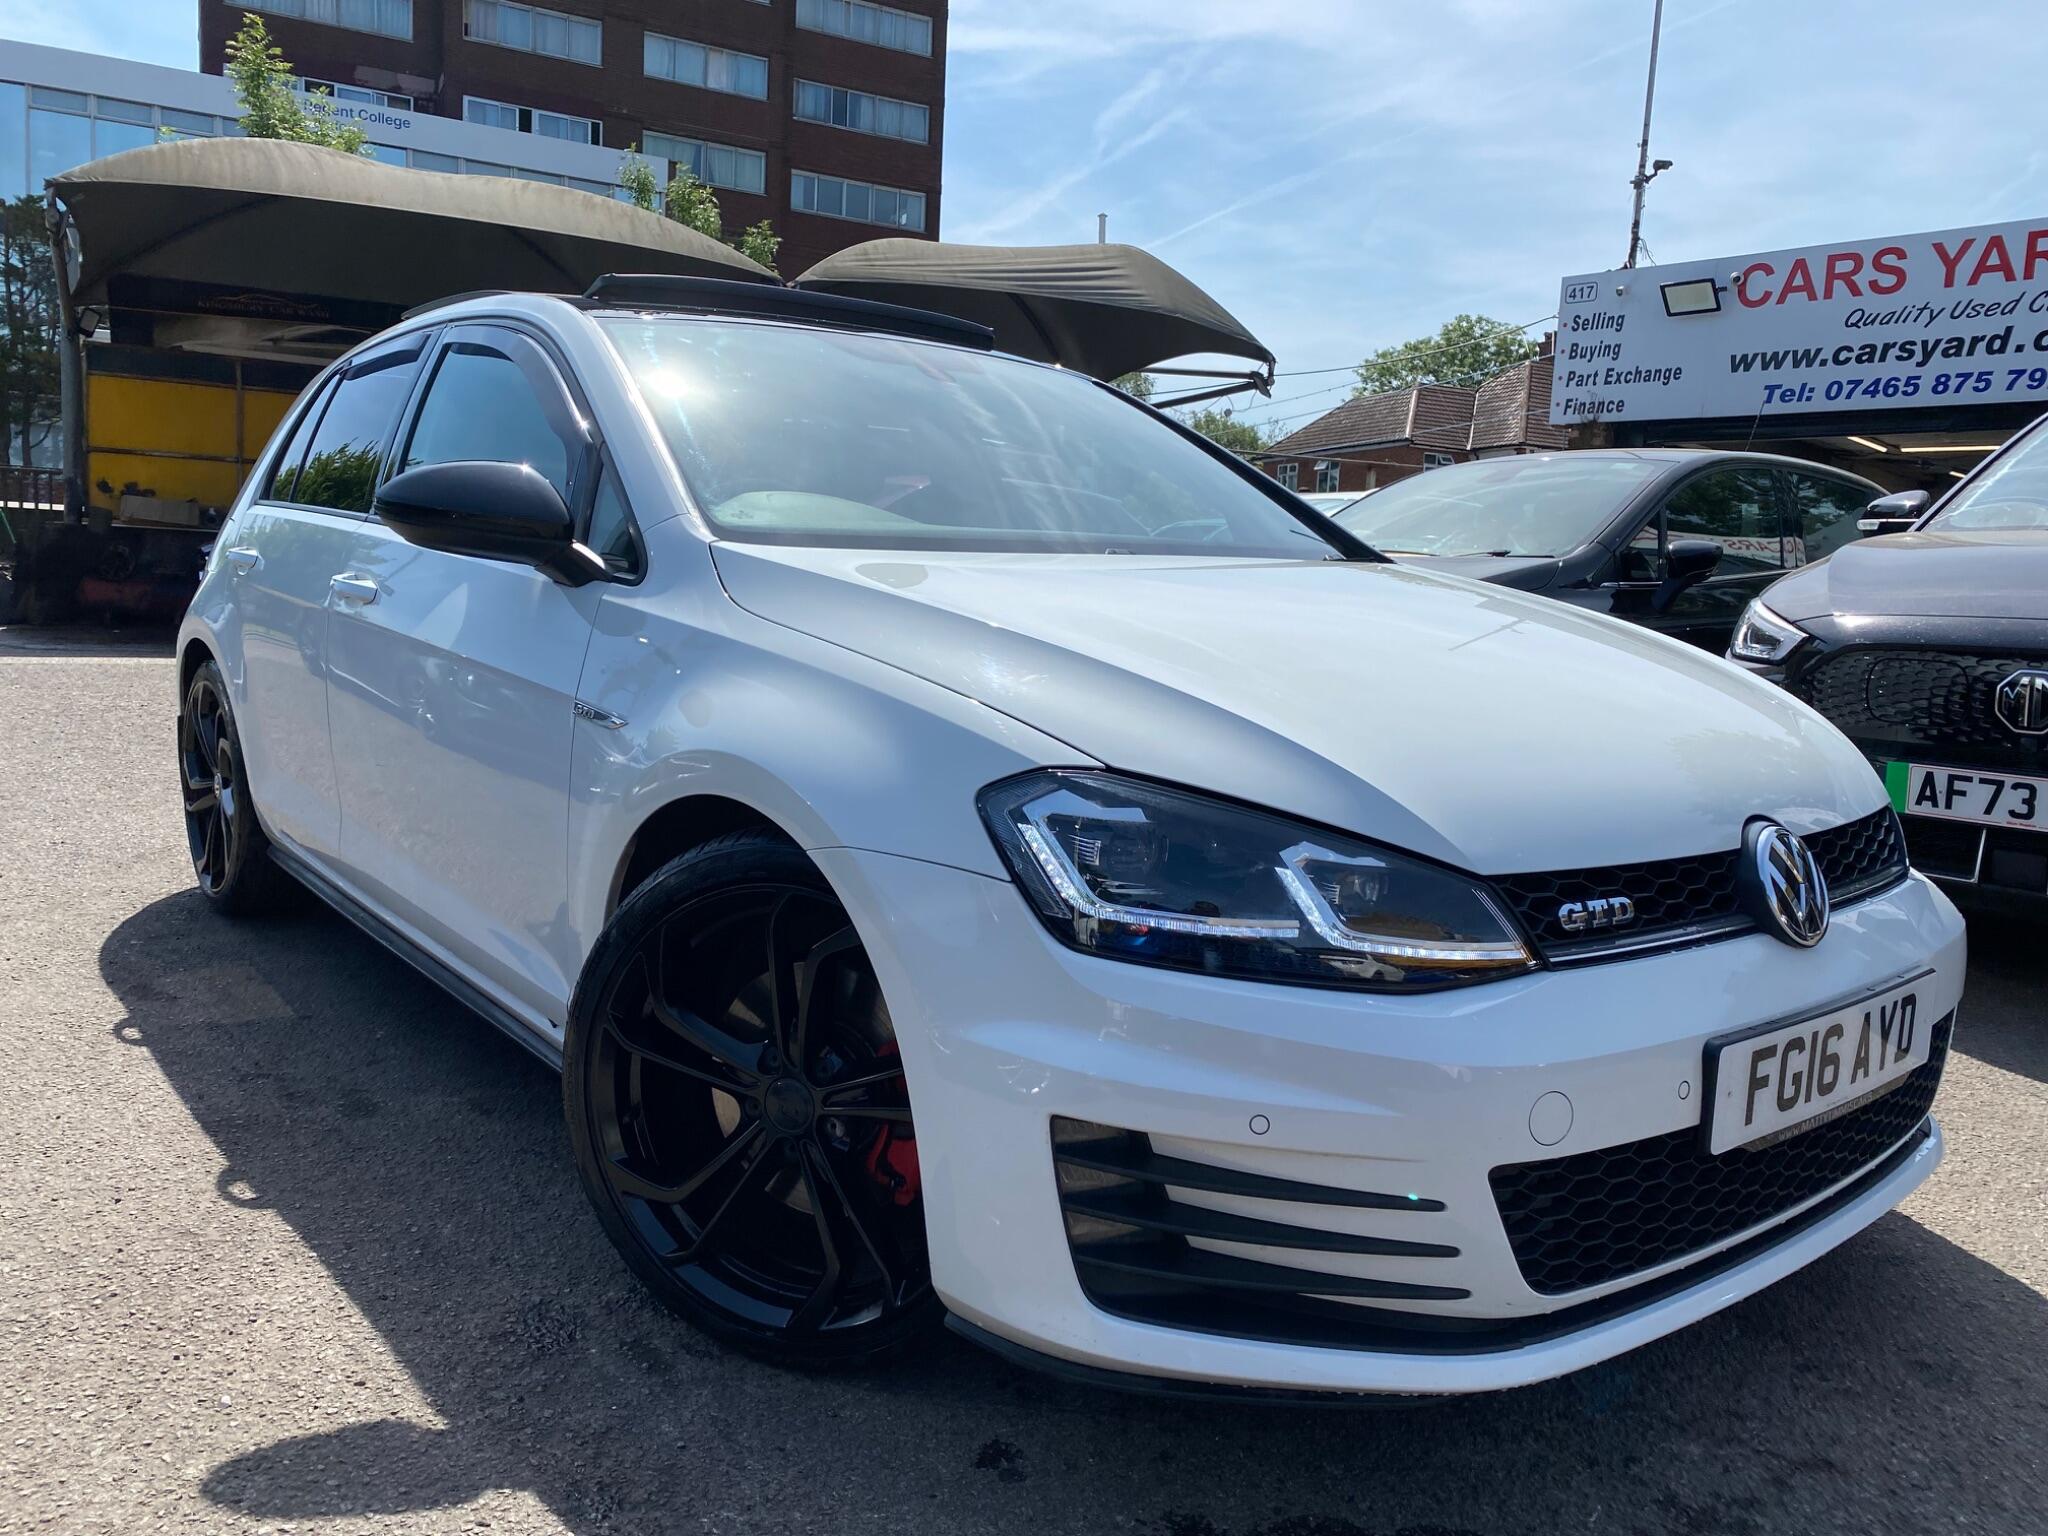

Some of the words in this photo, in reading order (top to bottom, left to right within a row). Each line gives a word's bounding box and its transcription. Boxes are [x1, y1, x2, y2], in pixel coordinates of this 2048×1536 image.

[358, 109, 411, 130] College
[1737, 247, 1908, 308] CARS
[1568, 285, 1595, 300] 417
[1571, 312, 1625, 332] Selling
[1845, 301, 1946, 329] Quality
[1950, 290, 2026, 320] Used
[2029, 290, 2048, 314] C
[1568, 340, 1622, 363] Buying
[1565, 370, 1599, 388] Part
[1603, 366, 1683, 386] Exchange
[1763, 382, 1815, 404] Tel:
[1825, 375, 1921, 401] 07465
[1931, 371, 1994, 395] 875
[1563, 398, 1625, 416] Finance
[1914, 770, 2038, 821] AF73
[1558, 896, 1635, 932] GTD
[1744, 1022, 1845, 1127] FG16
[1850, 992, 1917, 1085] AYD
